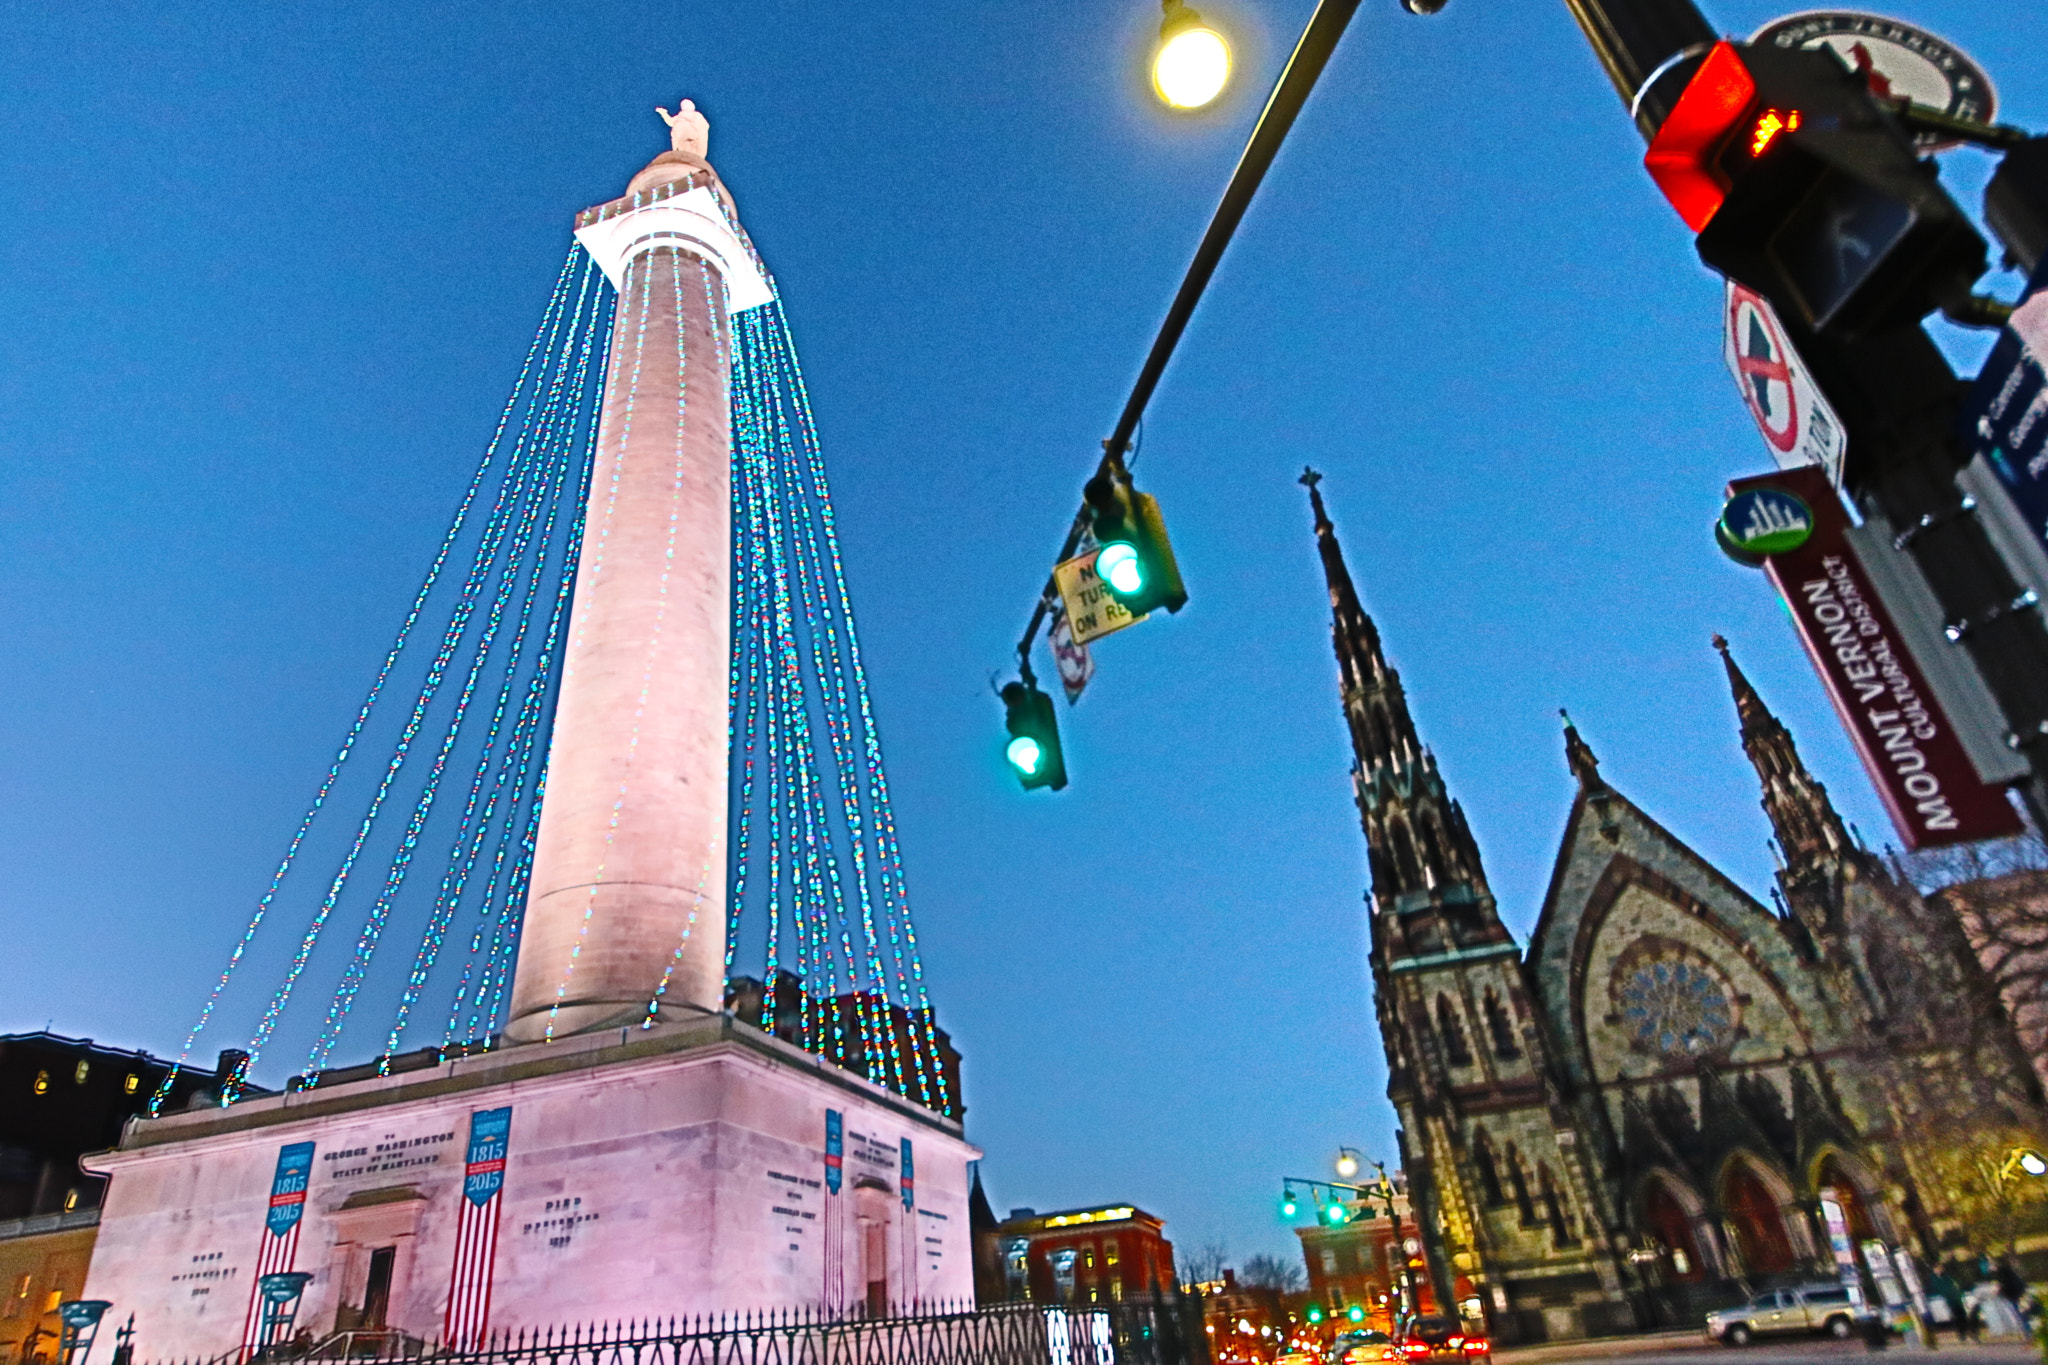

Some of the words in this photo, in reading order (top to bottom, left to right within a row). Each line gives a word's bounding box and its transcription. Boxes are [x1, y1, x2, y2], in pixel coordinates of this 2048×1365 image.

[1077, 582, 1108, 606] TUR
[1822, 555, 1880, 637] DISTRICT
[1076, 611, 1098, 634] ON
[1105, 603, 1128, 622] RE
[1802, 578, 1886, 704] VERNON
[1870, 635, 1936, 740] CULTURAL
[1868, 707, 1960, 831] MOUNT
[323, 1146, 368, 1162] GEORGE
[375, 1131, 456, 1153] WASHINGTON
[471, 1142, 504, 1164] 1815
[332, 1166, 364, 1179] STATE
[366, 1164, 378, 1173] OF
[381, 1154, 439, 1171] MARYLAND
[275, 1175, 305, 1195] 1815
[467, 1170, 501, 1192] 2015
[269, 1202, 300, 1222] 2015
